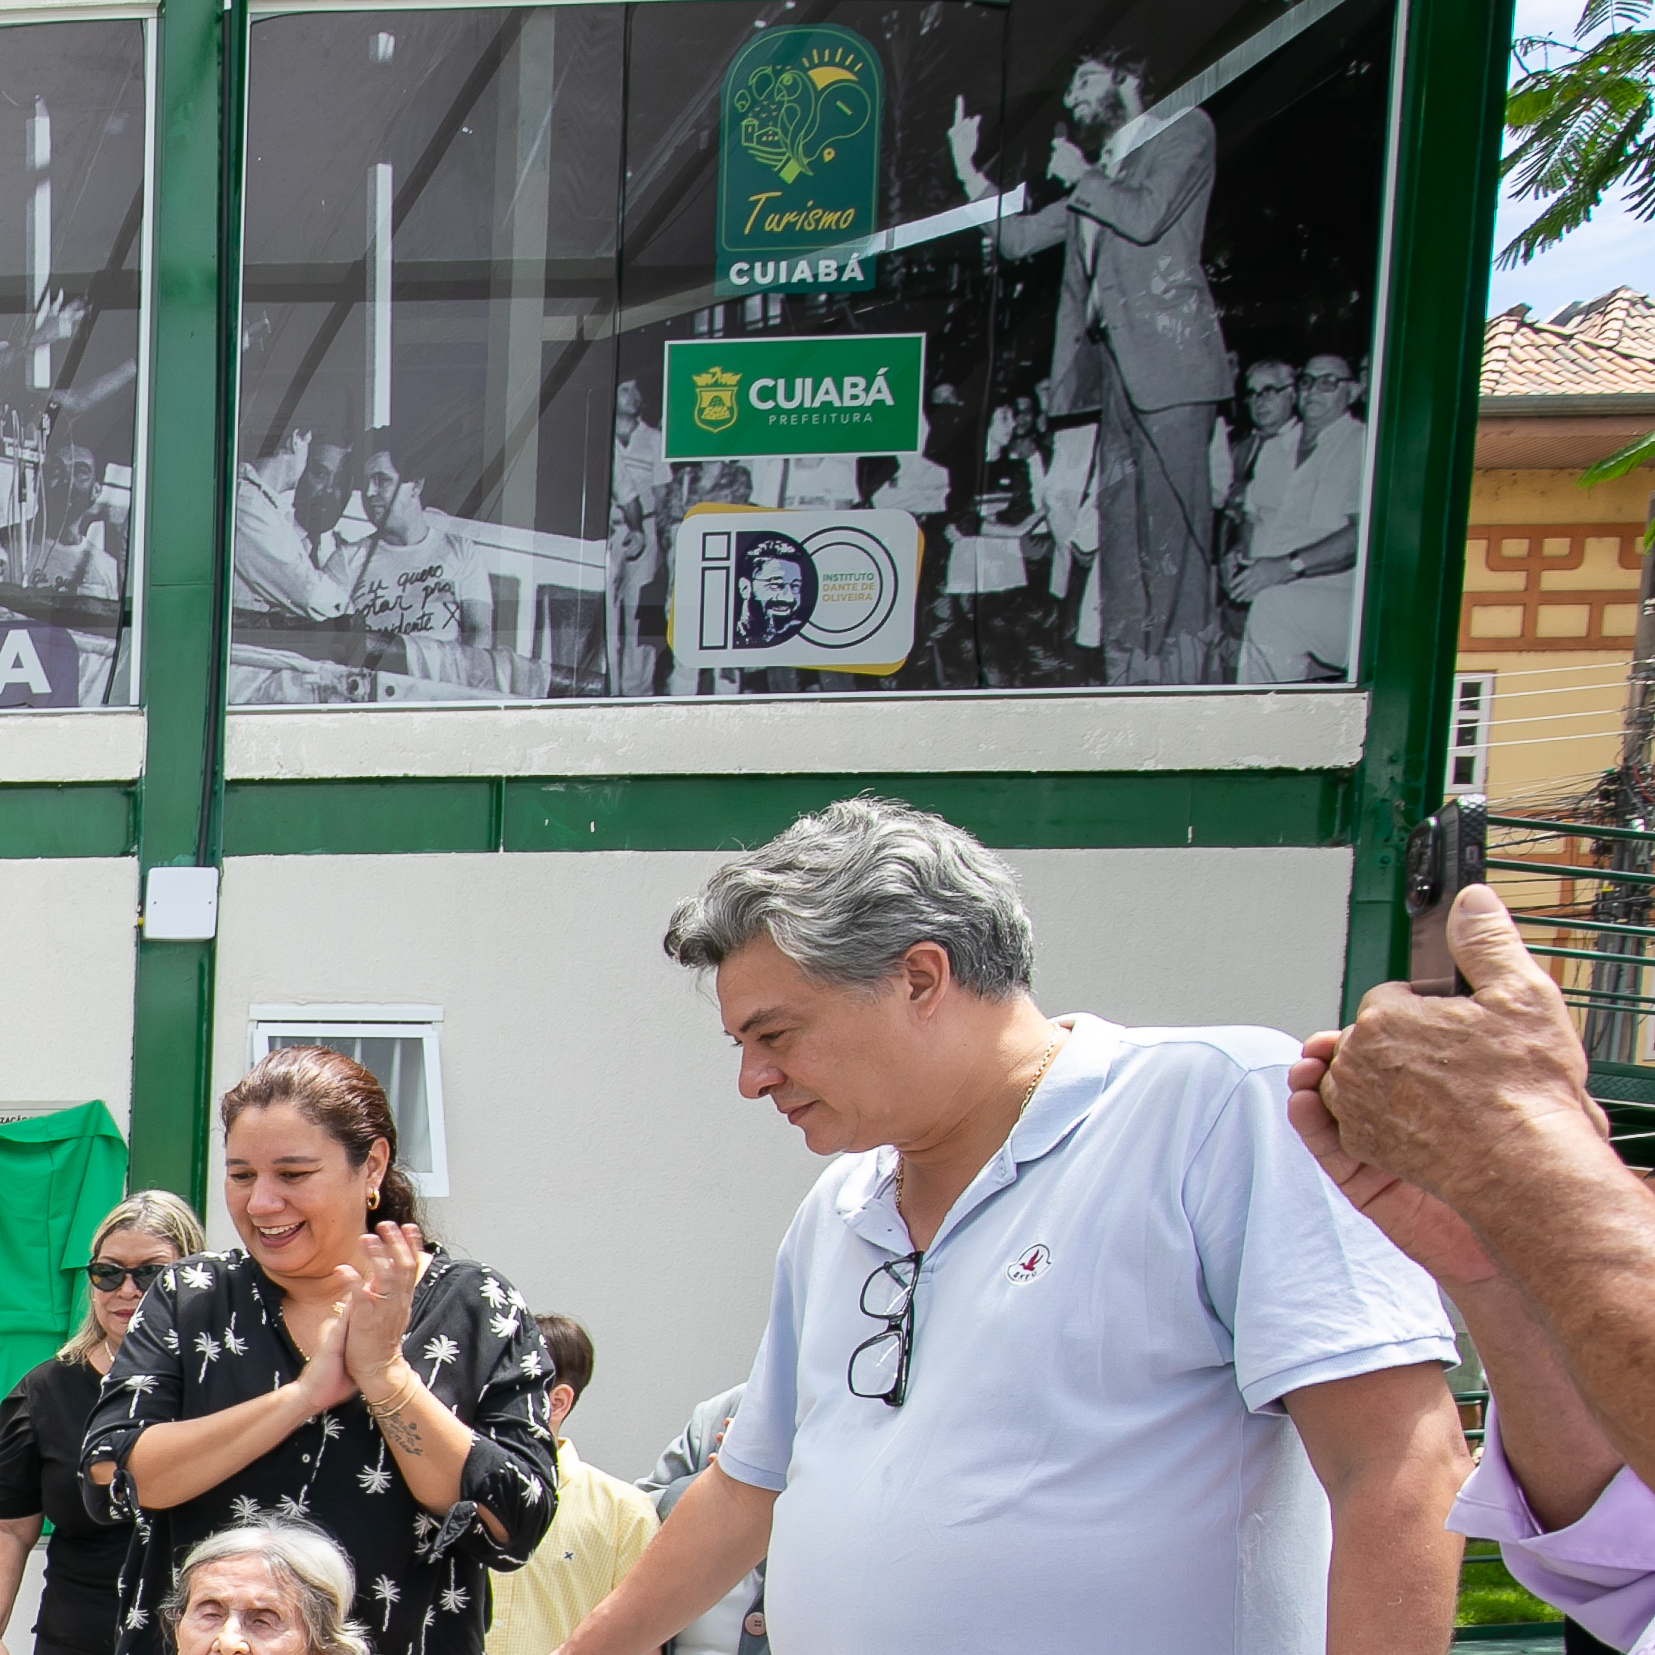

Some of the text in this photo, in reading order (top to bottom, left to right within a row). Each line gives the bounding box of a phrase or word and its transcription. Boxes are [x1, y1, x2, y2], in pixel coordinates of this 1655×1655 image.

[744, 191, 856, 235] Turismo
[728, 252, 865, 286] CUIABÁ
[748, 366, 896, 411] CUIABÁ
[768, 412, 874, 426] PREFEITURA
[822, 572, 875, 582] INSTITUTO
[822, 582, 875, 592] DANTE DE
[822, 592, 873, 603] OLIVEIRA
